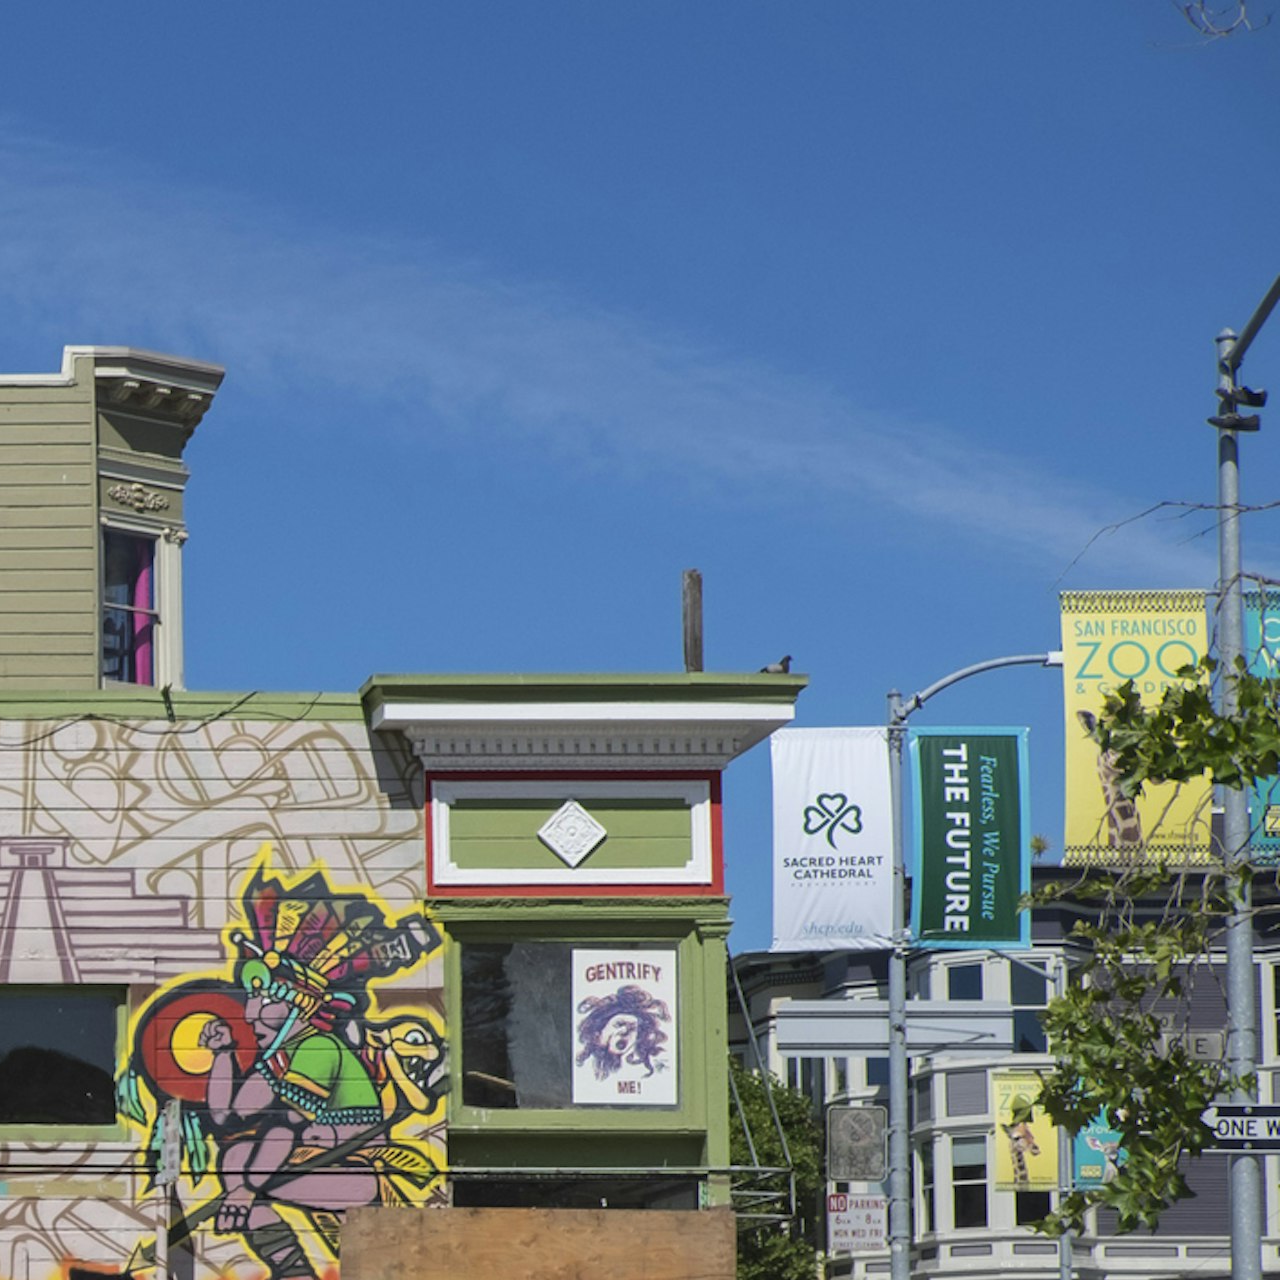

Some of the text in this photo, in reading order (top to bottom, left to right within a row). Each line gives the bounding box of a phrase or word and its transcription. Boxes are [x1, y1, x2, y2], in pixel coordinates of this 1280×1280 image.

[1074, 619, 1197, 636] SAN FRANCISCO
[1074, 640, 1198, 680] ZOO
[1075, 682, 1086, 694] &
[942, 743, 971, 932] THE FUTURE
[979, 755, 1000, 920] Fearless, We Pursue
[783, 855, 884, 868] SACRED HEART
[793, 868, 873, 880] CATHEDRAL
[585, 960, 662, 983] GENTRIFY
[617, 1080, 642, 1095] ME!
[1217, 1118, 1257, 1136] ONE
[829, 1195, 847, 1212] NO
